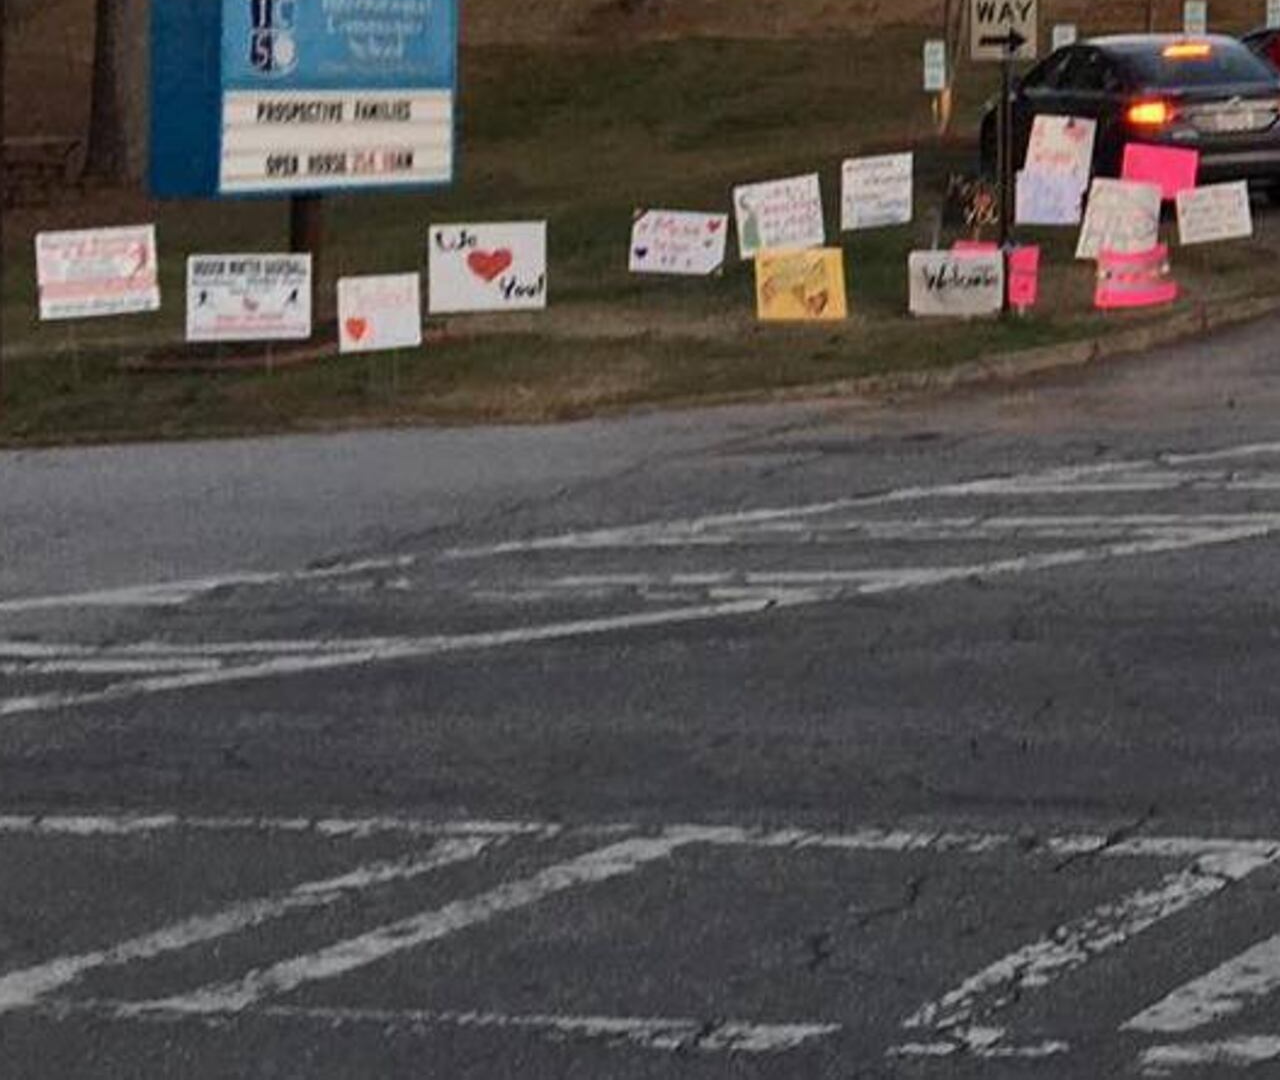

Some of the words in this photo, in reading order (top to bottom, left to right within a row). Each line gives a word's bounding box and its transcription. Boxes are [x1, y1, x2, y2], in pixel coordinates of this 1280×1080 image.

[977, 0, 1033, 22] WAY
[256, 99, 344, 122] PROSPECTIVE
[354, 99, 411, 121] FAMILIES
[266, 153, 298, 176] OPEN
[307, 152, 346, 174] HOUSE
